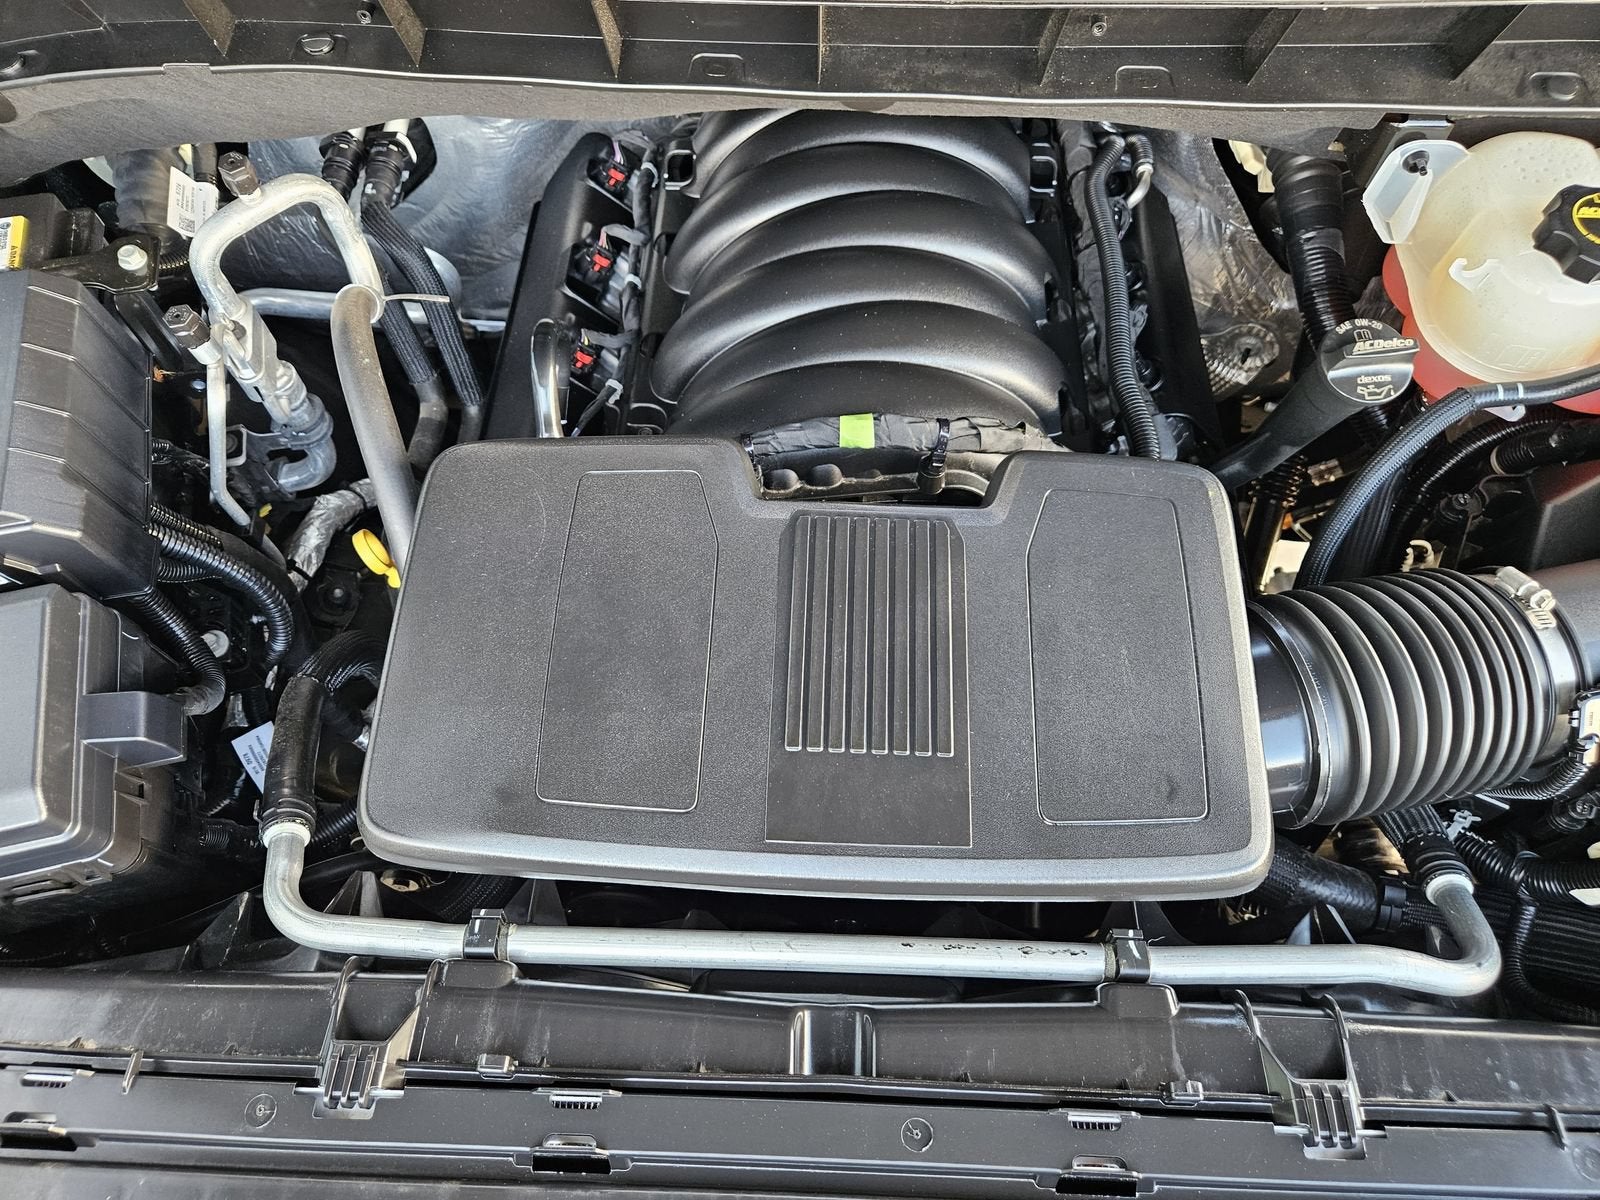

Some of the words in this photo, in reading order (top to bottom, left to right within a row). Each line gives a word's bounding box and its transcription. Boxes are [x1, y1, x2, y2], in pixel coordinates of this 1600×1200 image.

[1335, 321, 1353, 335] SAE
[1355, 318, 1383, 330] 0W-20
[1352, 338, 1415, 352] ACDelco
[1357, 375, 1392, 384] dexos
